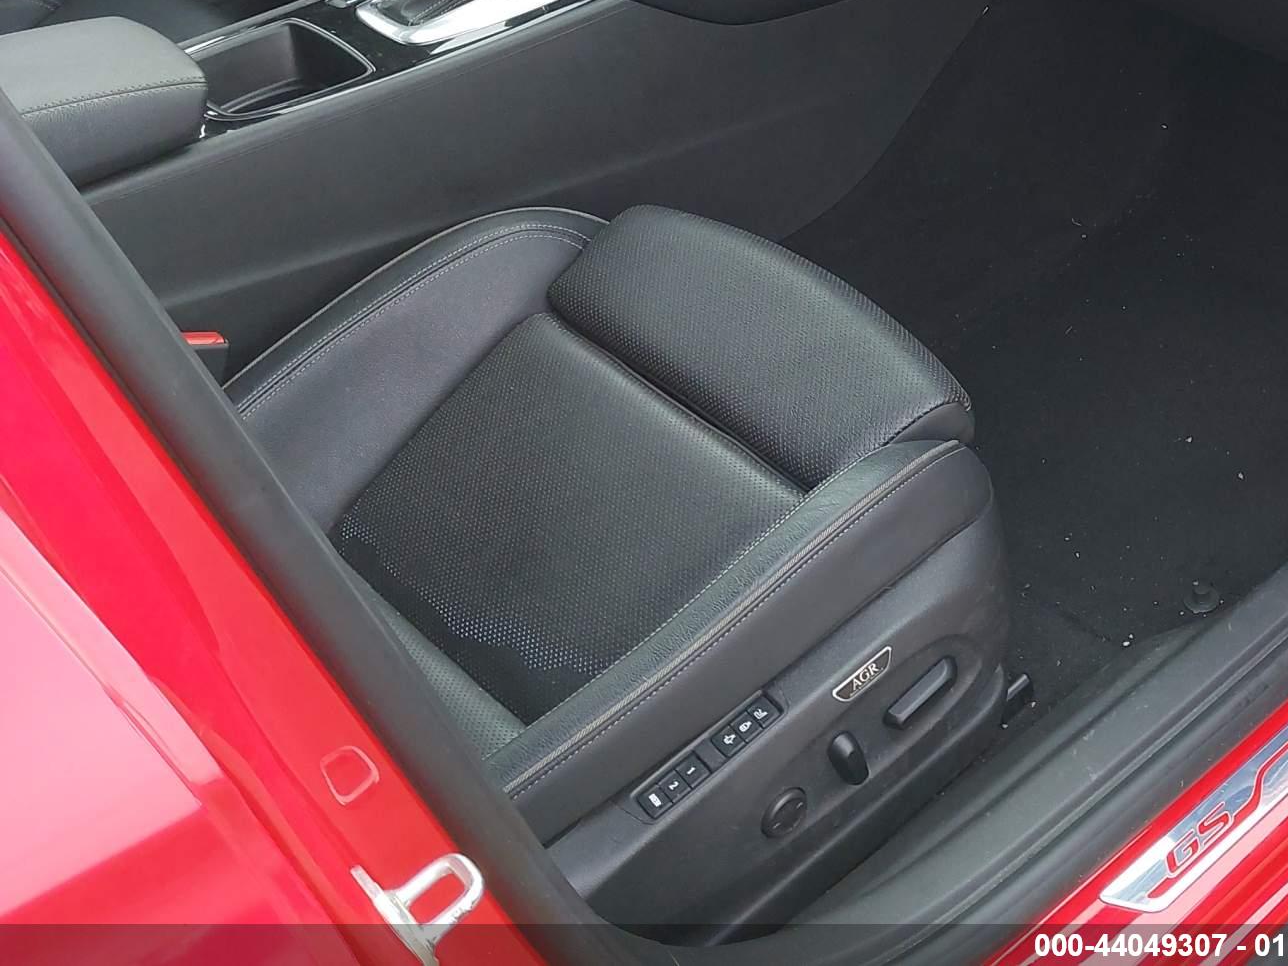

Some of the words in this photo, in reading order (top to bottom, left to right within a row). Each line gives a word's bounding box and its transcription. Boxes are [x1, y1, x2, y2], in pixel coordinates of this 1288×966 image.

[852, 662, 880, 691] AGR
[668, 780, 680, 791] 2
[1165, 801, 1232, 877] GS
